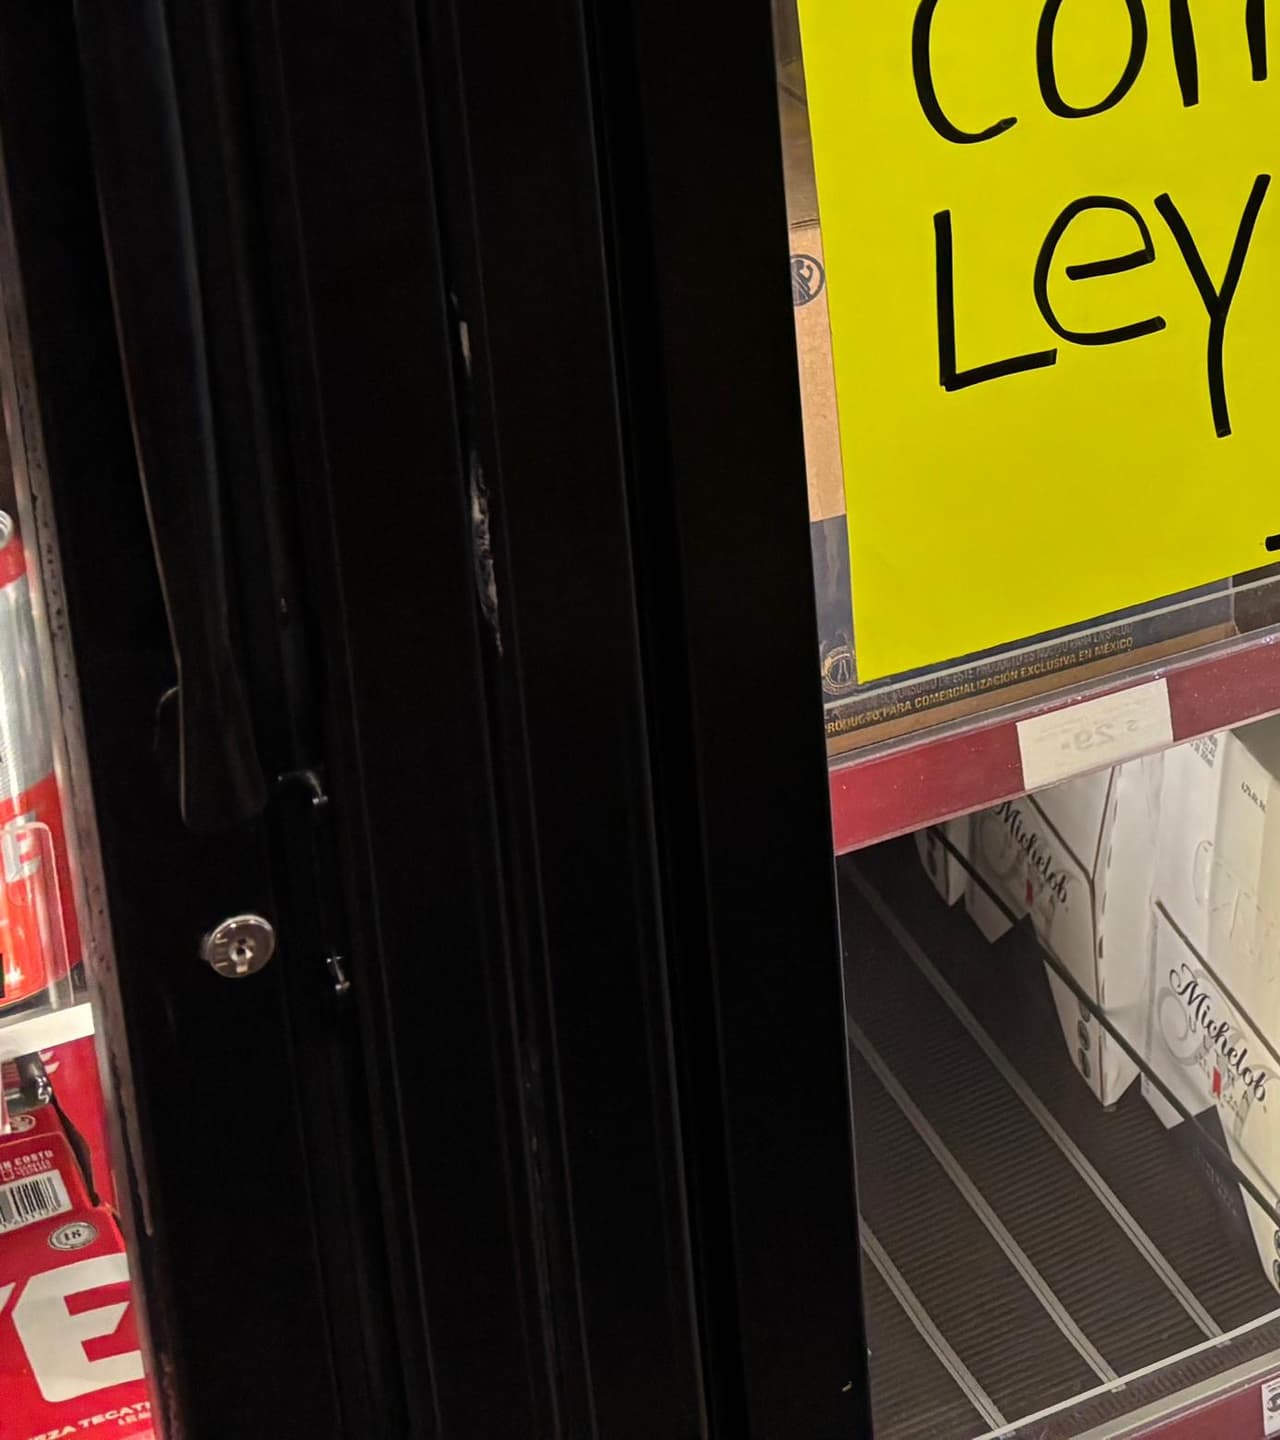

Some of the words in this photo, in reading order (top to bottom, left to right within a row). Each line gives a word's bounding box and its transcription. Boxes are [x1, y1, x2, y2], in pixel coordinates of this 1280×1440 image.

[915, 671, 1018, 708] COMERCIALIZACIÓN
[1021, 654, 1077, 679] EXCLUSIVA
[1095, 635, 1134, 657] MÉXICO
[1168, 962, 1267, 1104] Michelob
